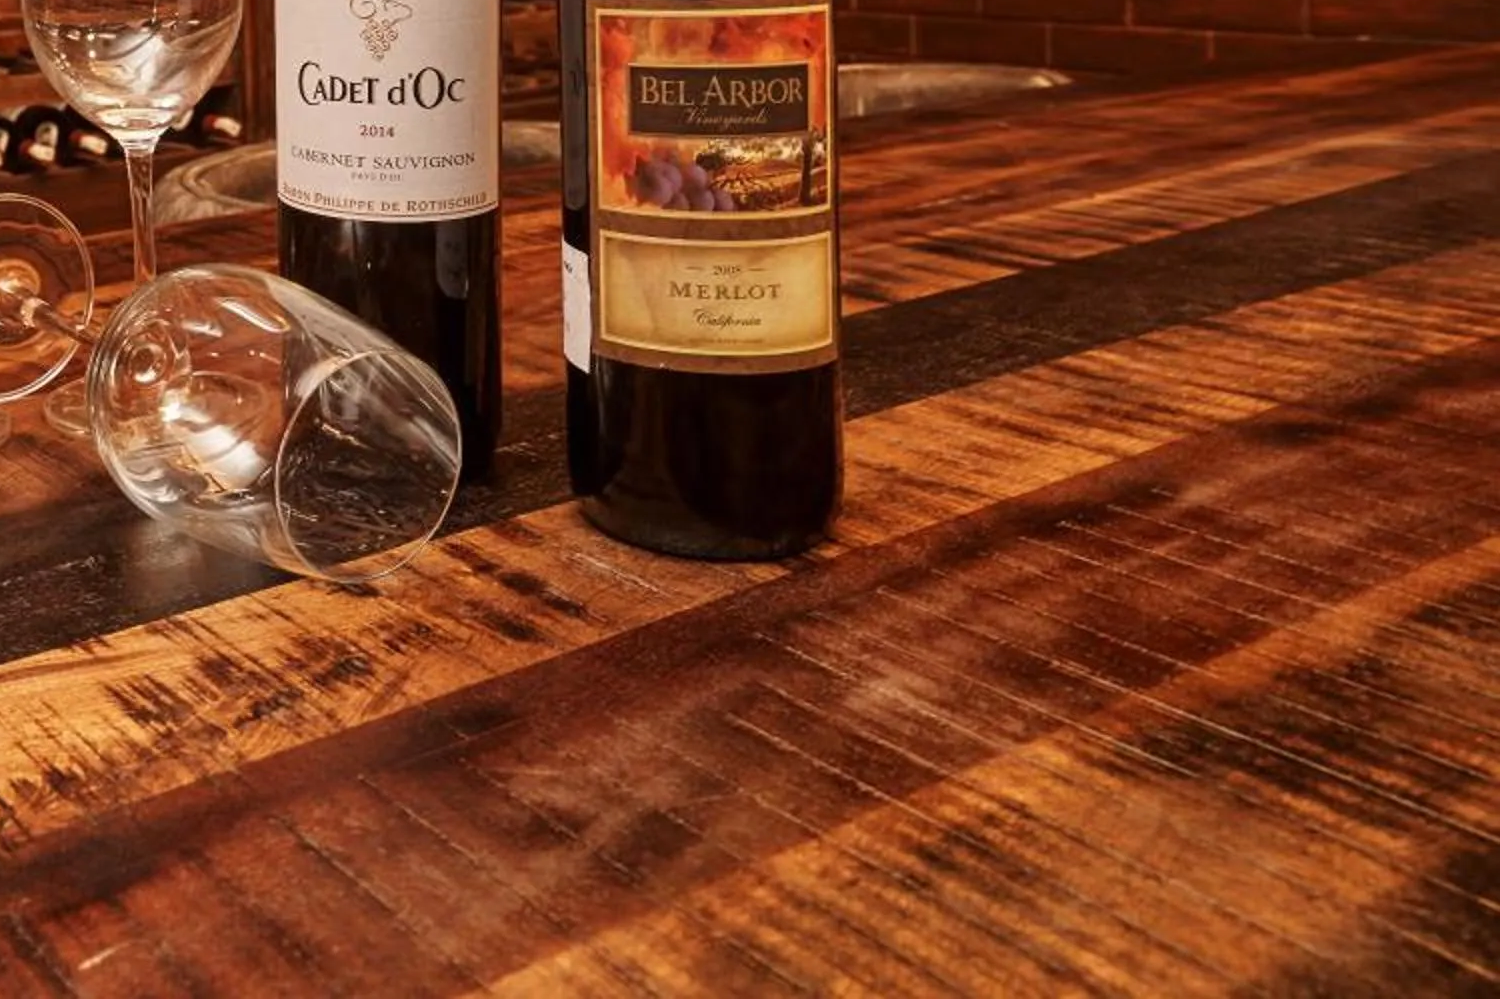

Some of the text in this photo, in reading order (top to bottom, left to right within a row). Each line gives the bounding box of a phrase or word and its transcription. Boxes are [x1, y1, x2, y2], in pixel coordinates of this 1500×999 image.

[640, 74, 804, 108] BEL ARBOR
[359, 124, 395, 138] 2014
[291, 145, 475, 170] CABERNET SAUVIGNON
[314, 192, 375, 212] PHILIPPE
[380, 201, 401, 212] DE
[406, 191, 487, 212] ROTHSCHILD
[668, 281, 782, 300] MERLOT
[692, 307, 763, 330] California
